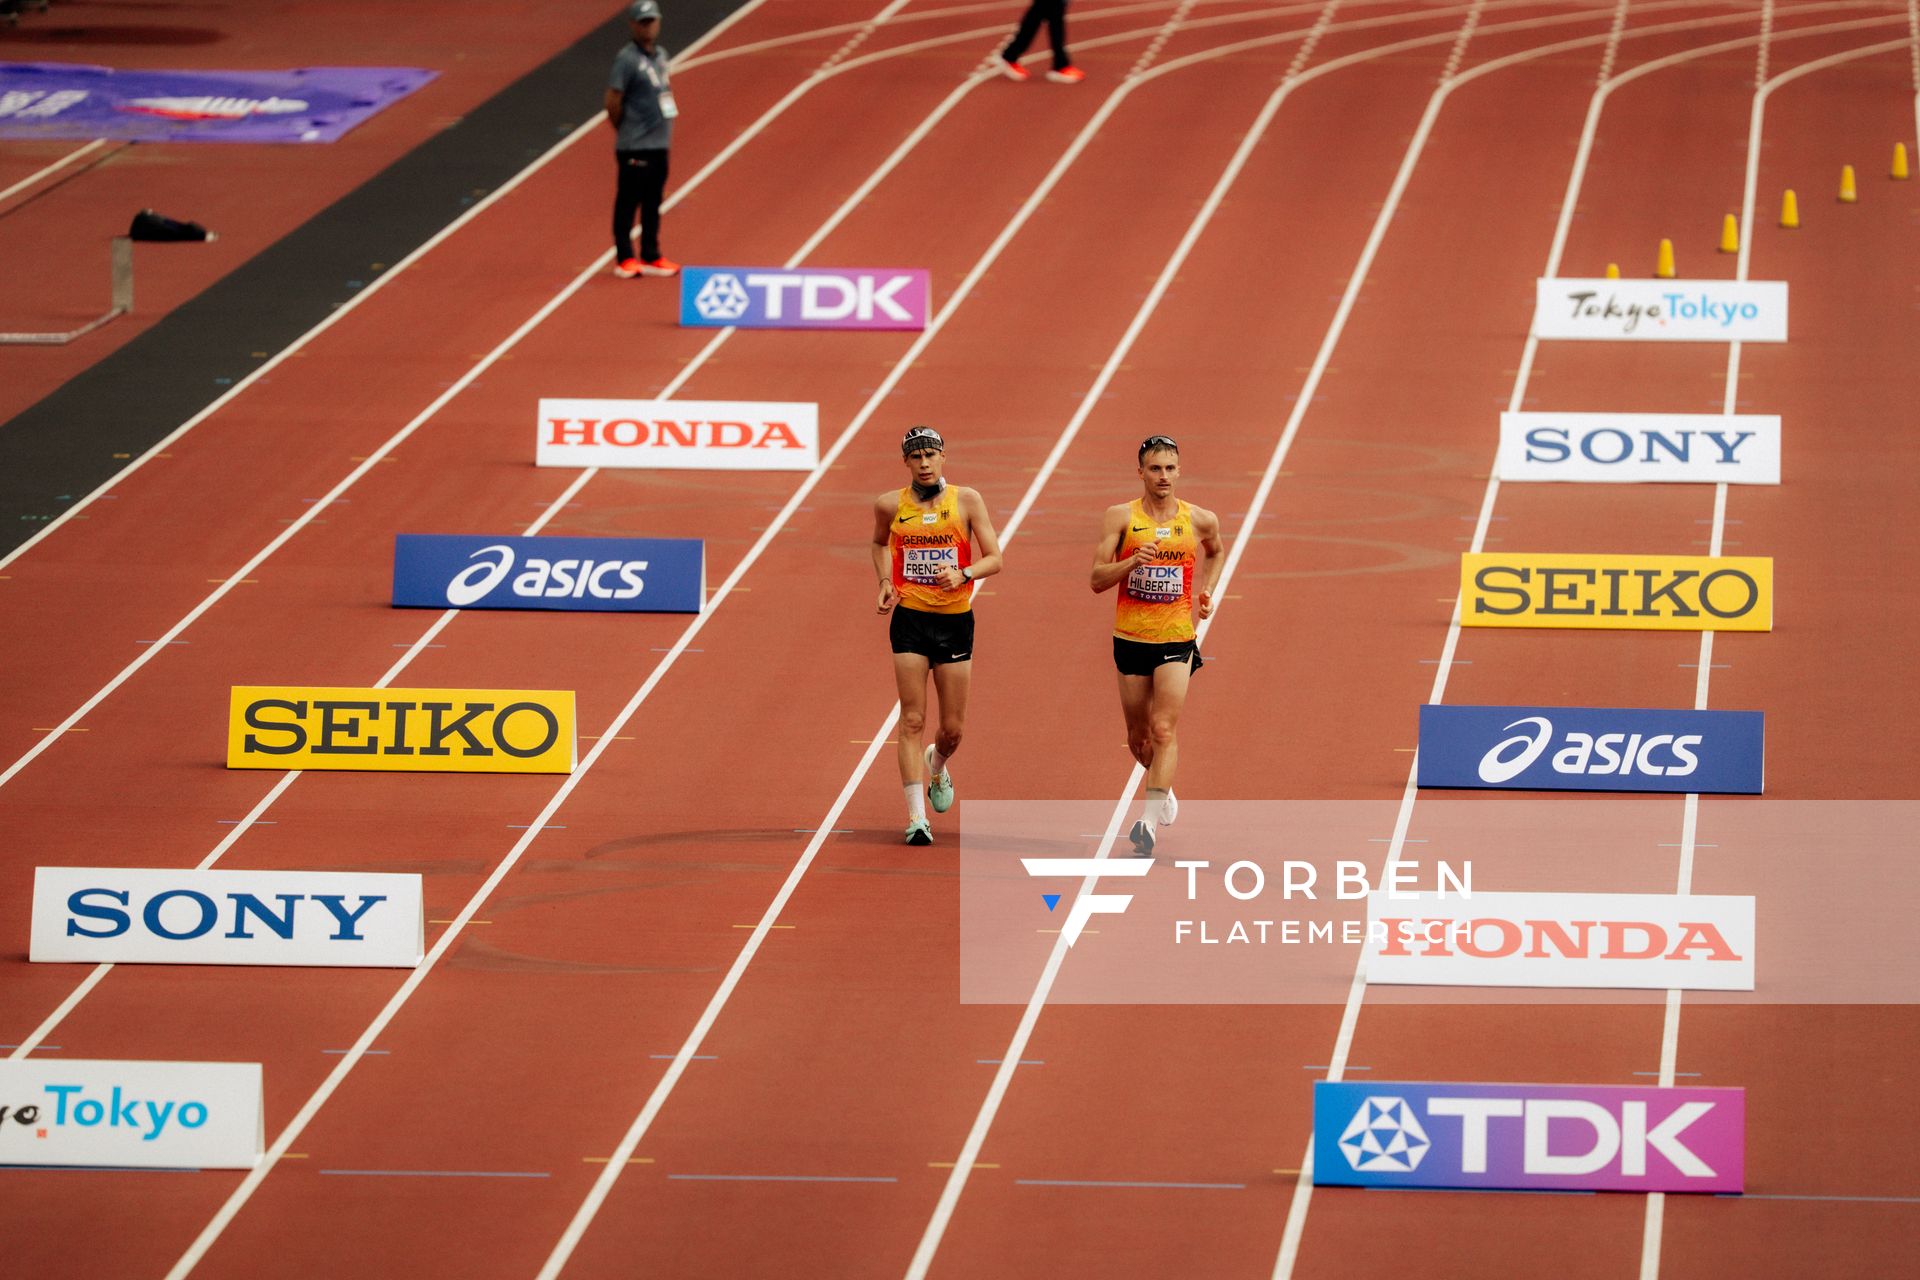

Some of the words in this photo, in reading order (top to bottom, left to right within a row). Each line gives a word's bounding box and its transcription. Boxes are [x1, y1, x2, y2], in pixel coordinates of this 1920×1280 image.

[747, 274, 913, 321] TDK
[1568, 291, 1661, 333] Tokyo
[1663, 293, 1759, 326] Tokyo
[546, 418, 806, 450] HONDA
[1525, 427, 1756, 465] SONY
[903, 534, 954, 545] GERMANY
[917, 548, 954, 560] TDK
[1133, 547, 1185, 560] GMANY
[906, 563, 942, 576] FRENZ
[1129, 576, 1170, 593] HILBERT
[1145, 567, 1179, 578] TDK
[1475, 566, 1759, 619] SEIKO
[244, 699, 559, 758] SEIKO
[66, 888, 388, 941] SONY
[1378, 917, 1743, 962] HONDA
[44, 1085, 208, 1140] Tokyo
[1427, 1097, 1720, 1178] TDK
